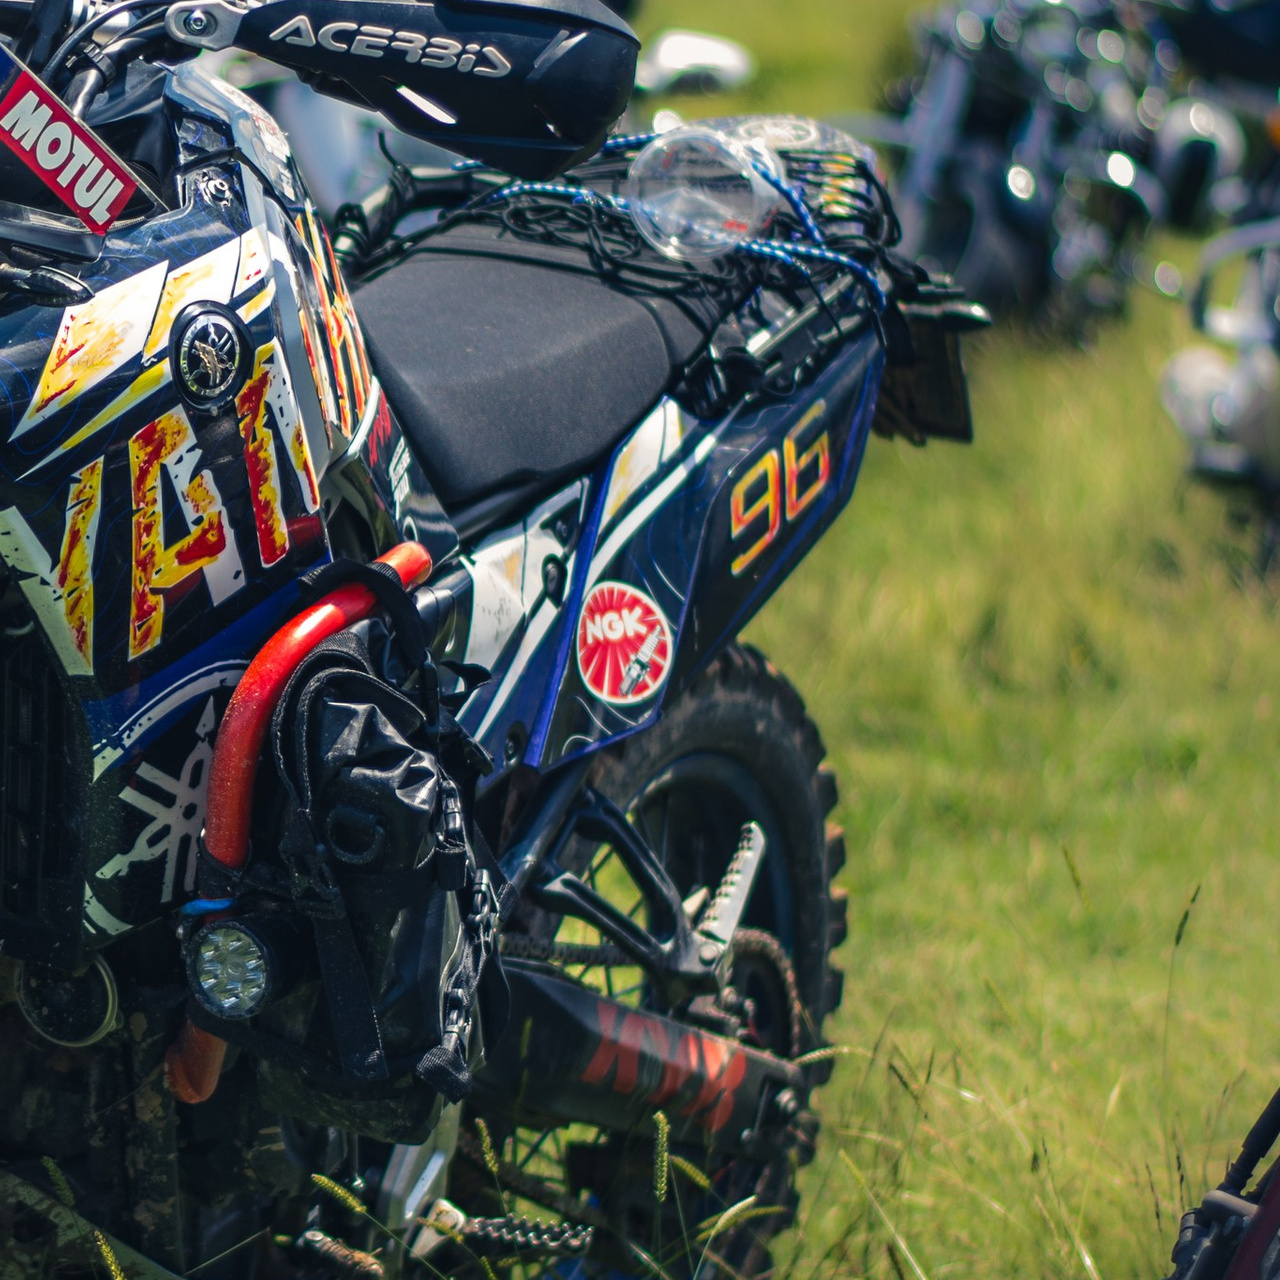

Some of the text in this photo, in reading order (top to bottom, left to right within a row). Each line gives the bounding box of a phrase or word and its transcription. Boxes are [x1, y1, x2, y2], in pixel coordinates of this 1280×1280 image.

[0, 90, 125, 226] MOTUL
[731, 398, 830, 576] 96
[586, 606, 647, 644] NGK
